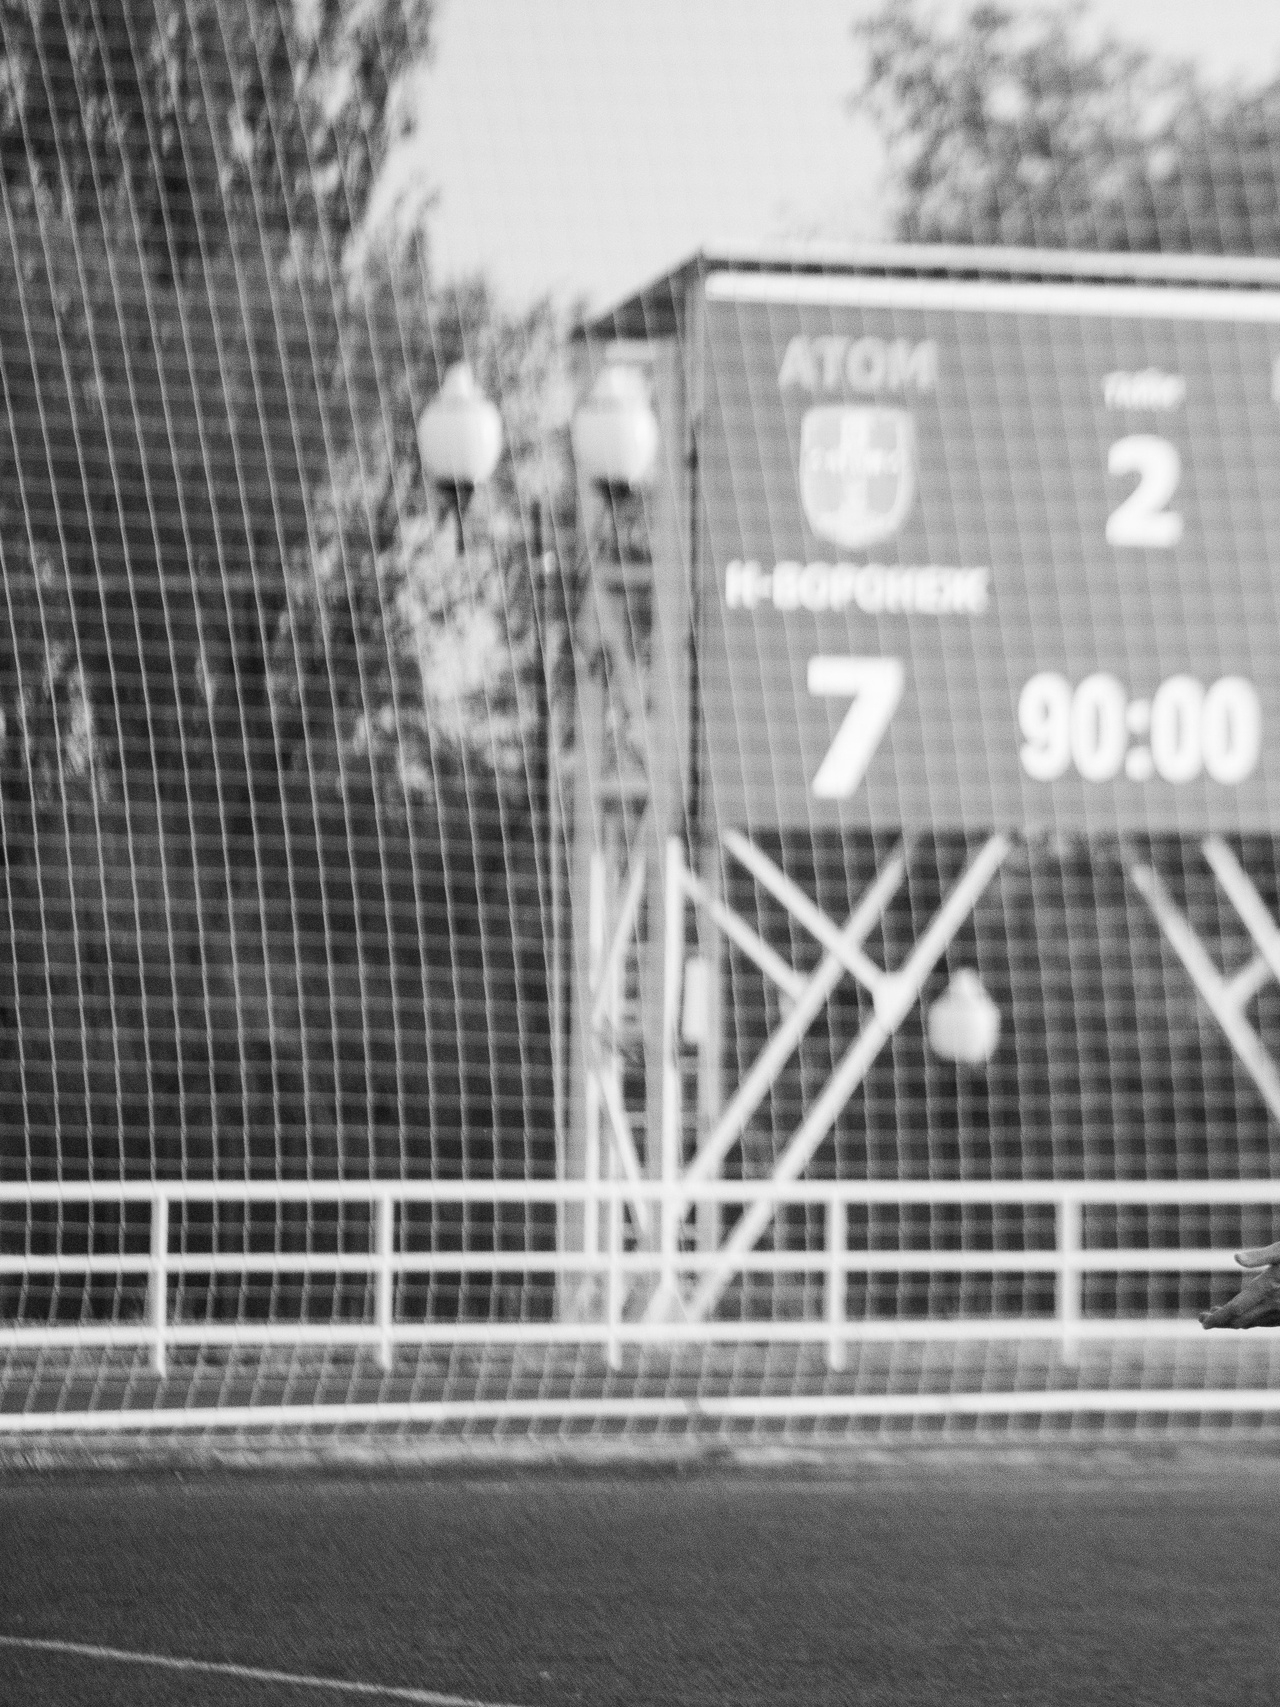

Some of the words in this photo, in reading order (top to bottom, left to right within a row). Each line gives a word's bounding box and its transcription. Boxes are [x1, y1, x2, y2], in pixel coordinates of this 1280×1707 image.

[778, 336, 938, 391] АТОМ
[1106, 434, 1182, 548] 2
[807, 655, 905, 799] 7
[1018, 671, 1261, 785] 90:00
